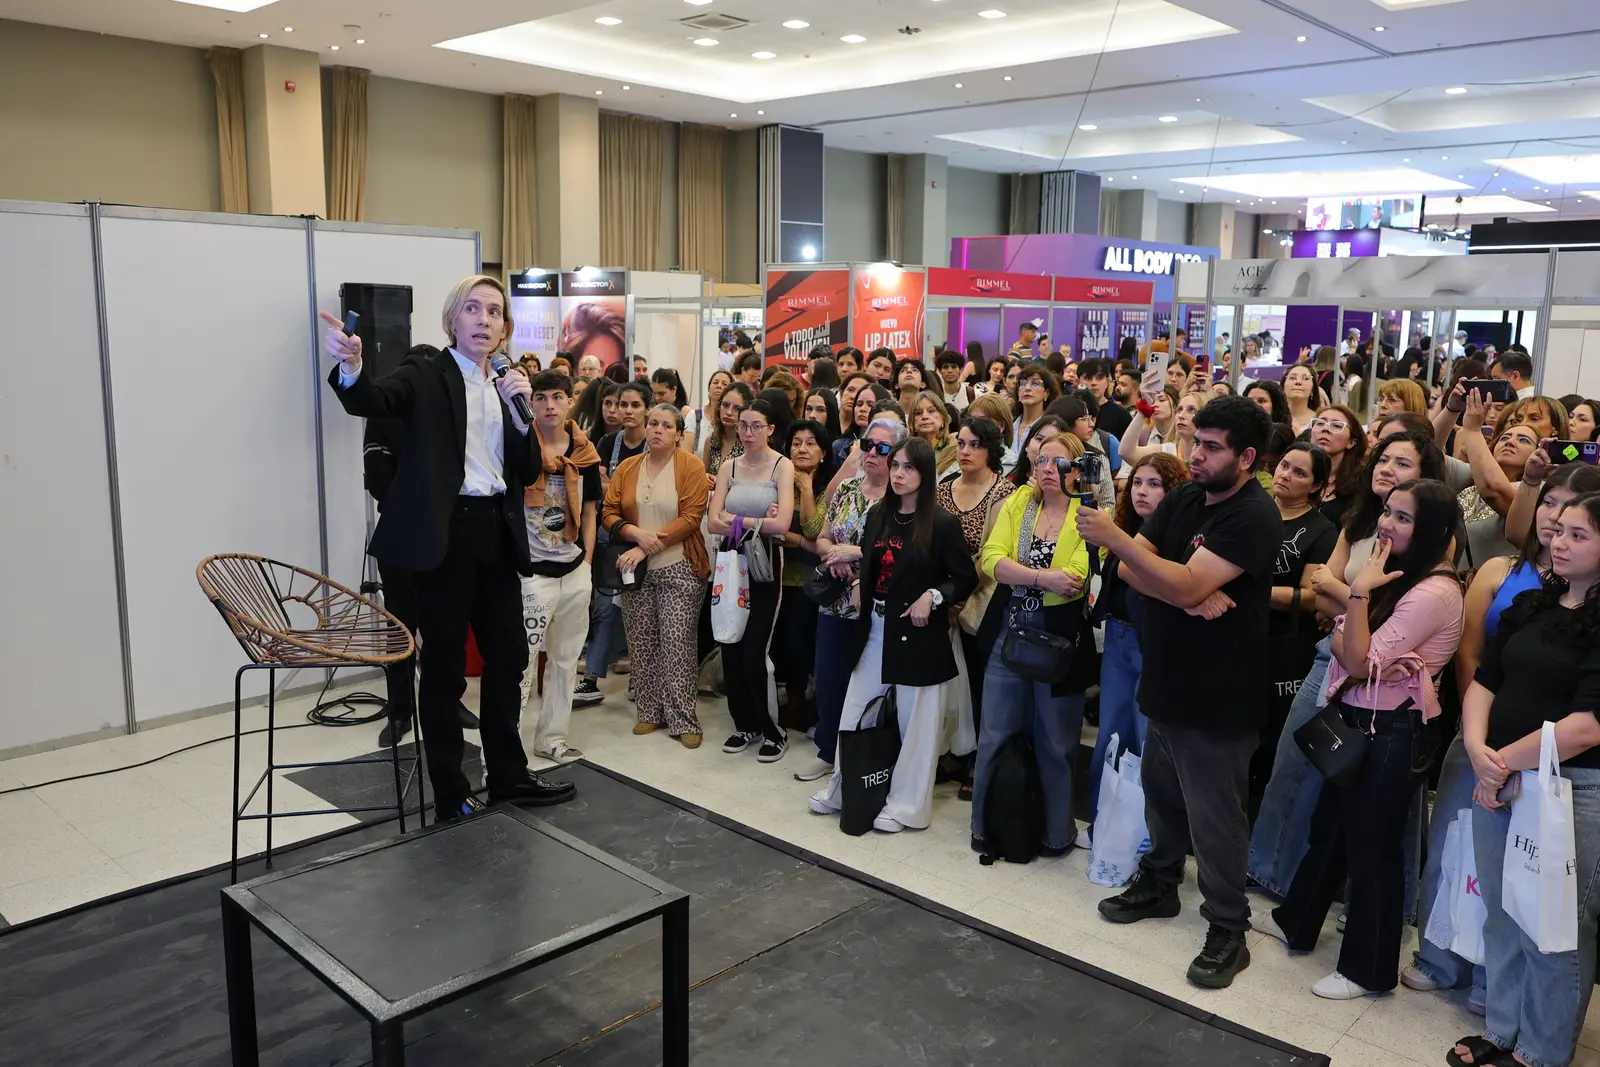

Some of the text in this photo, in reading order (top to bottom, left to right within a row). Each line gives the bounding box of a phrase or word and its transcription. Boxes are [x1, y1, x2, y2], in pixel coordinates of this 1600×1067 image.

[1104, 246, 1132, 272] ALL
[1133, 248, 1174, 275] BODY
[976, 278, 1011, 288] RIMMEL
[1092, 285, 1120, 294] RIMMEL
[787, 295, 829, 307] RIMMEL
[872, 296, 909, 307] RIMMEL
[880, 318, 898, 329] NUEVO
[534, 326, 555, 340] RESET
[784, 327, 814, 346] A TODO
[865, 330, 911, 352] LIP LATEX
[1275, 679, 1305, 696] TRE
[861, 766, 894, 789] TRES
